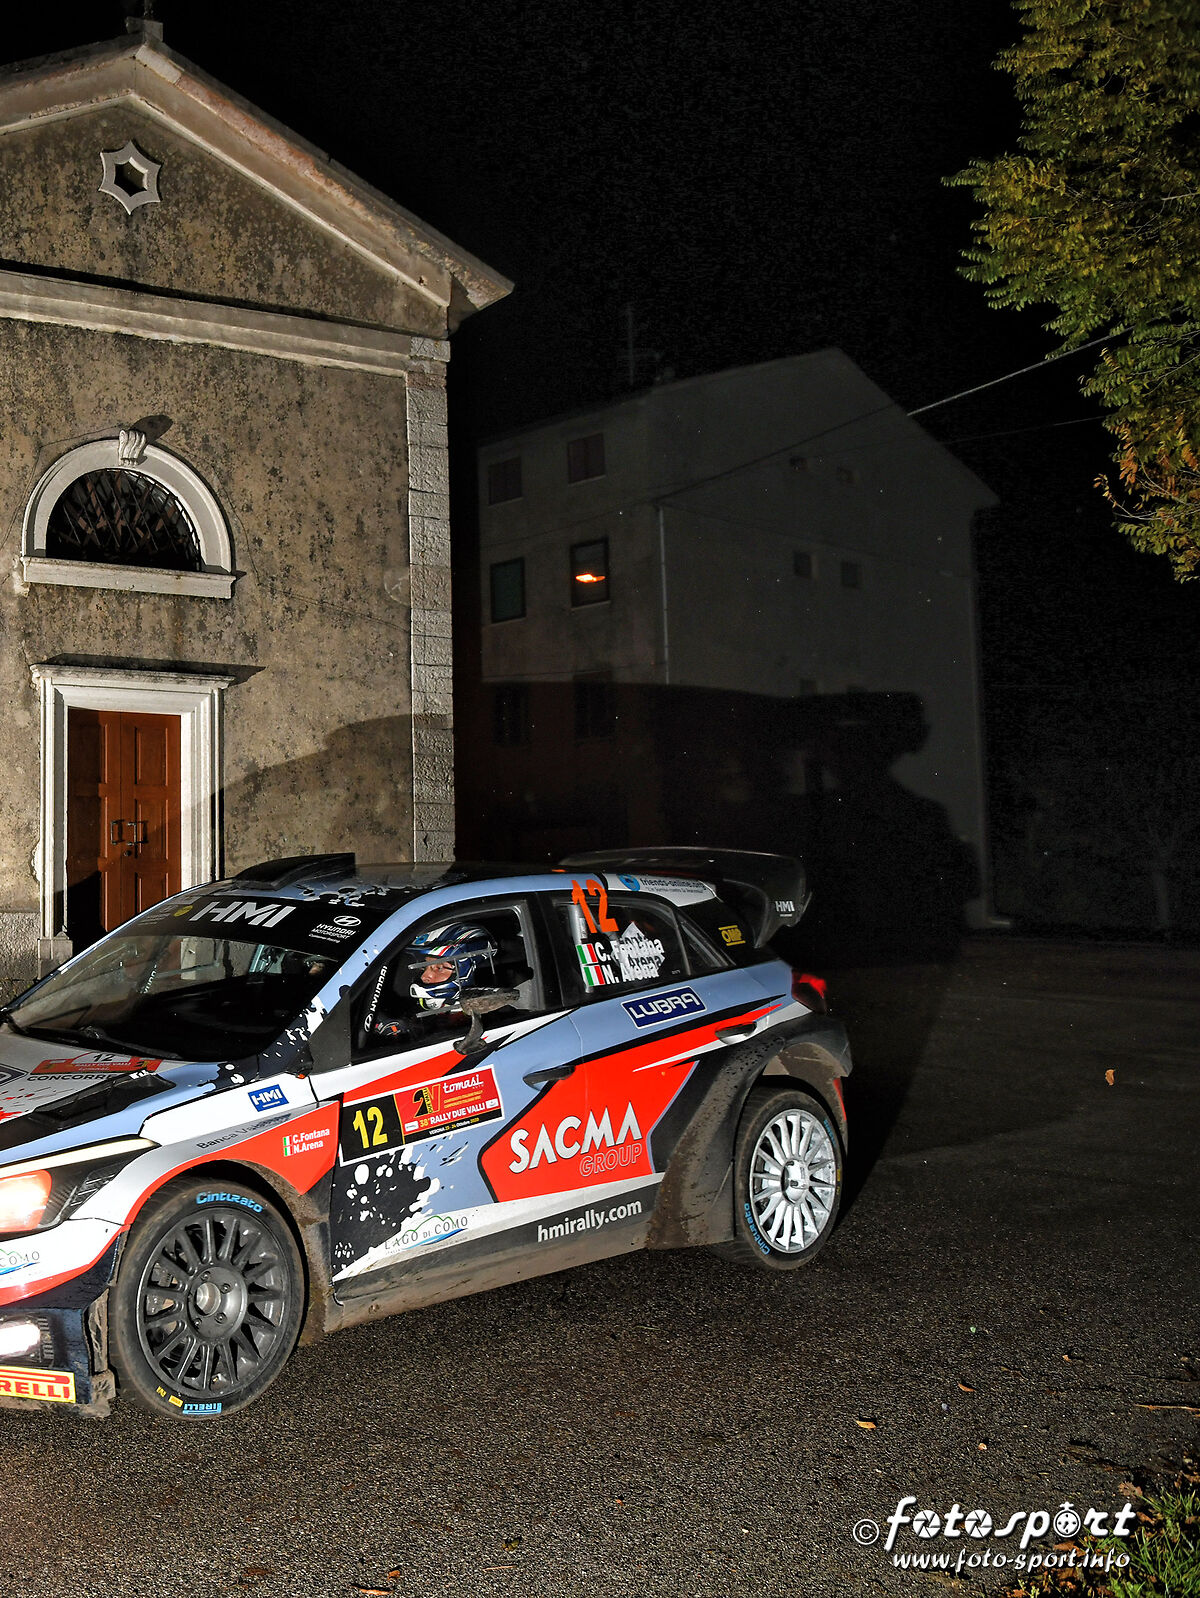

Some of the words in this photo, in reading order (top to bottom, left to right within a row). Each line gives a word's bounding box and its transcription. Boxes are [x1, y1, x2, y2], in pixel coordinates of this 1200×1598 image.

[190, 901, 297, 928] HMI
[571, 879, 619, 934] 12
[775, 901, 795, 912] HMI
[316, 923, 357, 936] HYUNDAI
[369, 965, 388, 1012] HYUNDAI
[628, 992, 701, 1019] LUBRA
[93, 1053, 116, 1063] 12
[443, 1074, 484, 1093] tomasi
[251, 1089, 283, 1106] HMI
[430, 1111, 452, 1125] RALLY
[451, 1107, 467, 1119] DUE
[466, 1102, 486, 1115] VALLI
[292, 1127, 331, 1144] C.Fontana
[352, 1106, 389, 1149] 12
[508, 1100, 643, 1174] SACMA
[196, 1131, 238, 1150] Banca
[293, 1139, 324, 1155] N.Arena
[579, 1142, 643, 1177] GROUP
[196, 1191, 264, 1213] Cinturato
[536, 1200, 643, 1243] hmirally.com
[384, 1230, 419, 1250] LAGO
[435, 1216, 468, 1235] COMO
[182, 1402, 222, 1415] PIRELLI
